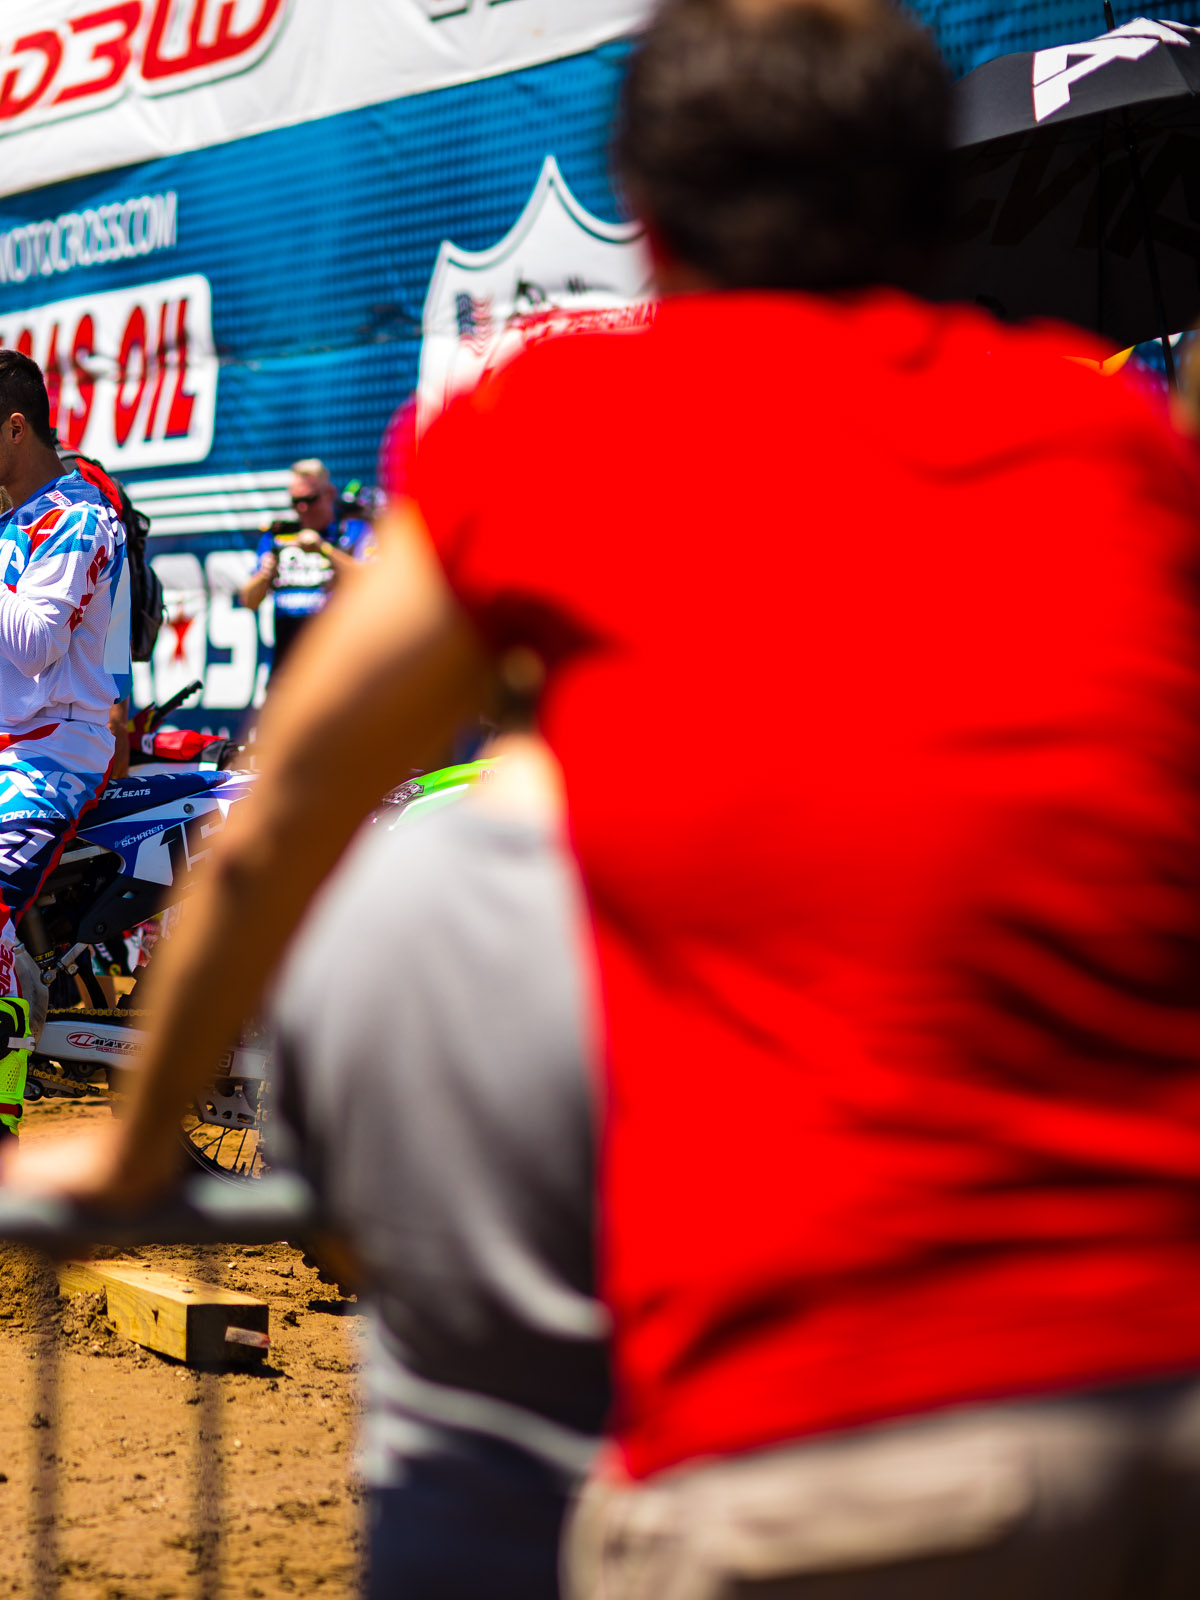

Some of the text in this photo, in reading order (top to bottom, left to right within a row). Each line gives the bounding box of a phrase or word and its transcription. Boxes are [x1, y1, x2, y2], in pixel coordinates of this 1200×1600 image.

[114, 297, 196, 448] OIL
[122, 788, 151, 798] SEATS
[121, 824, 165, 848] SCHARER
